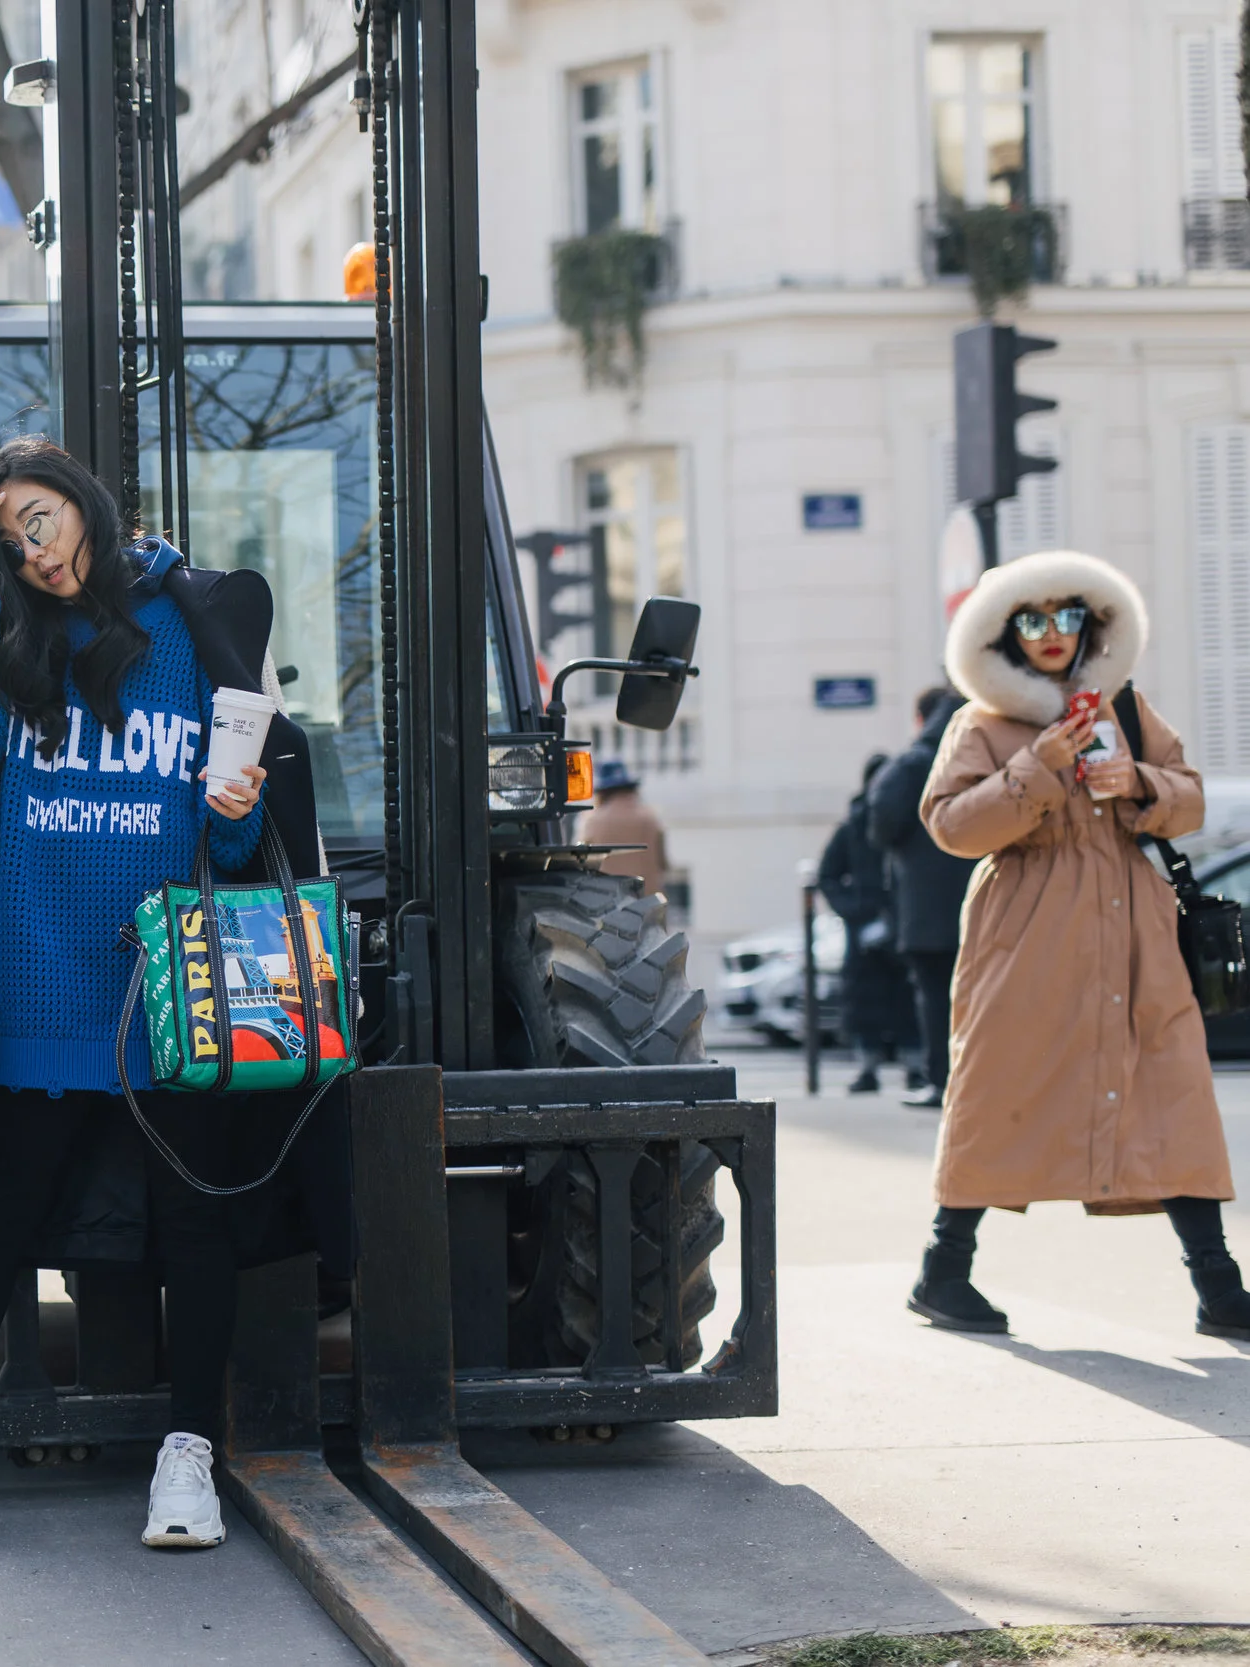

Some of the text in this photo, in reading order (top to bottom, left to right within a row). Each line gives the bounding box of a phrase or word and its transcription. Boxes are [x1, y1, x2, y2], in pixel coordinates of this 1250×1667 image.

[99, 708, 202, 784] LOVE
[26, 795, 162, 835] GIVENCHY PARIS
[181, 910, 219, 1059] PARIS
[156, 1000, 173, 1037] PARIS
[163, 1036, 174, 1071] PARIS
